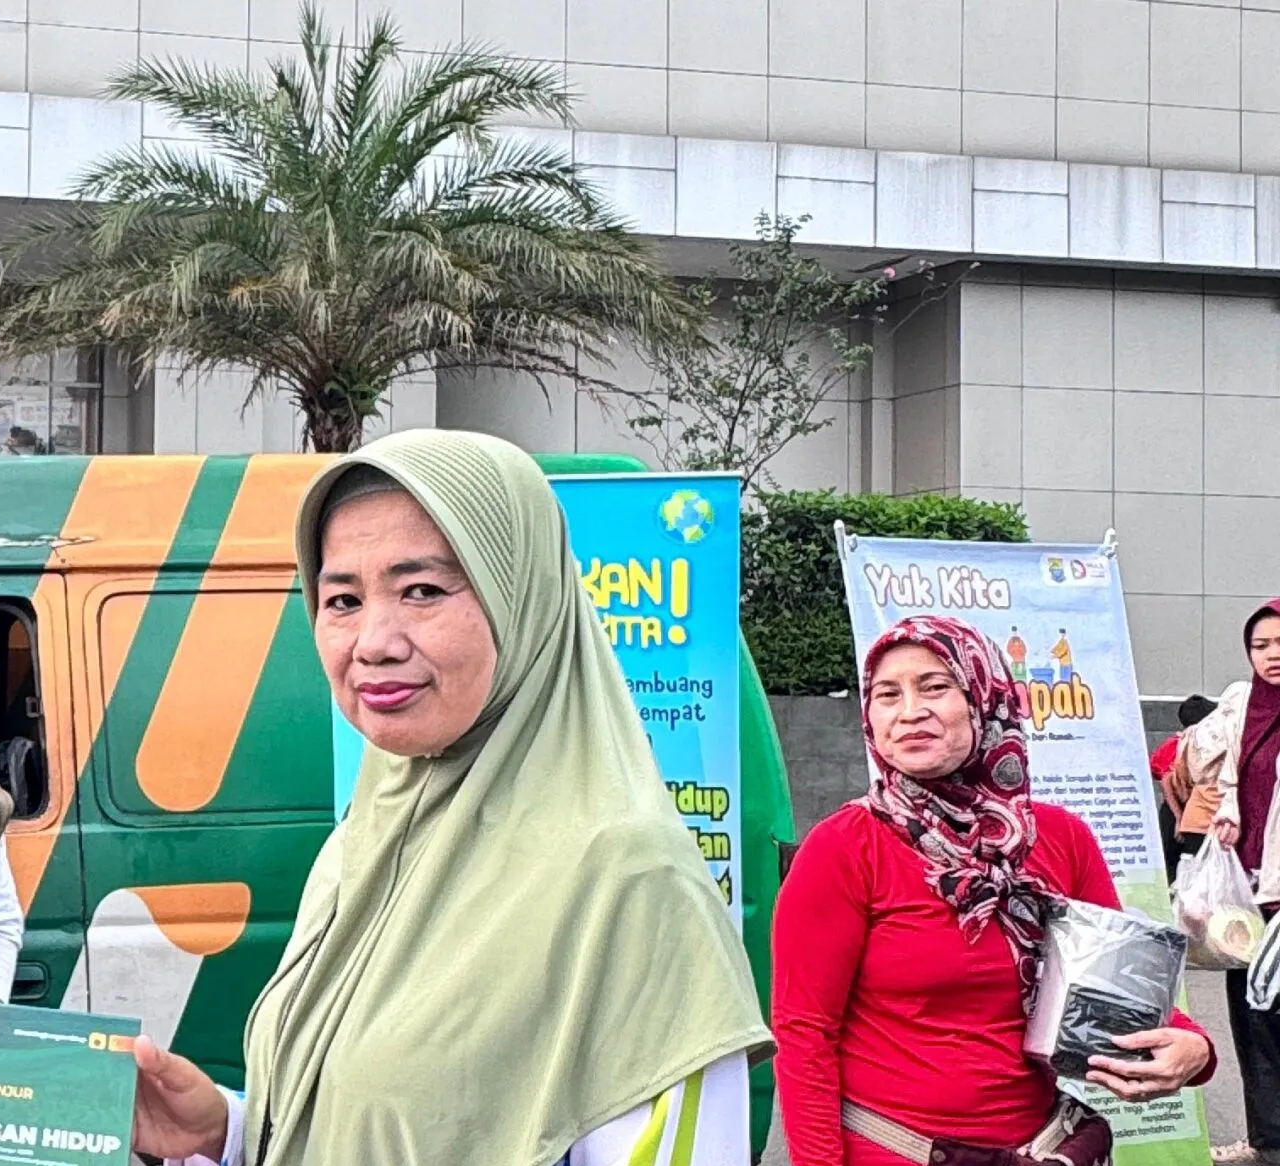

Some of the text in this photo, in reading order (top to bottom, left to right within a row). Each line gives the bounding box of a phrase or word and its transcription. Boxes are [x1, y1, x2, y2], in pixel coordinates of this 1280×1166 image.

[864, 563, 1012, 609] Yuk Kita
[42, 1127, 121, 1154] HIDUP
